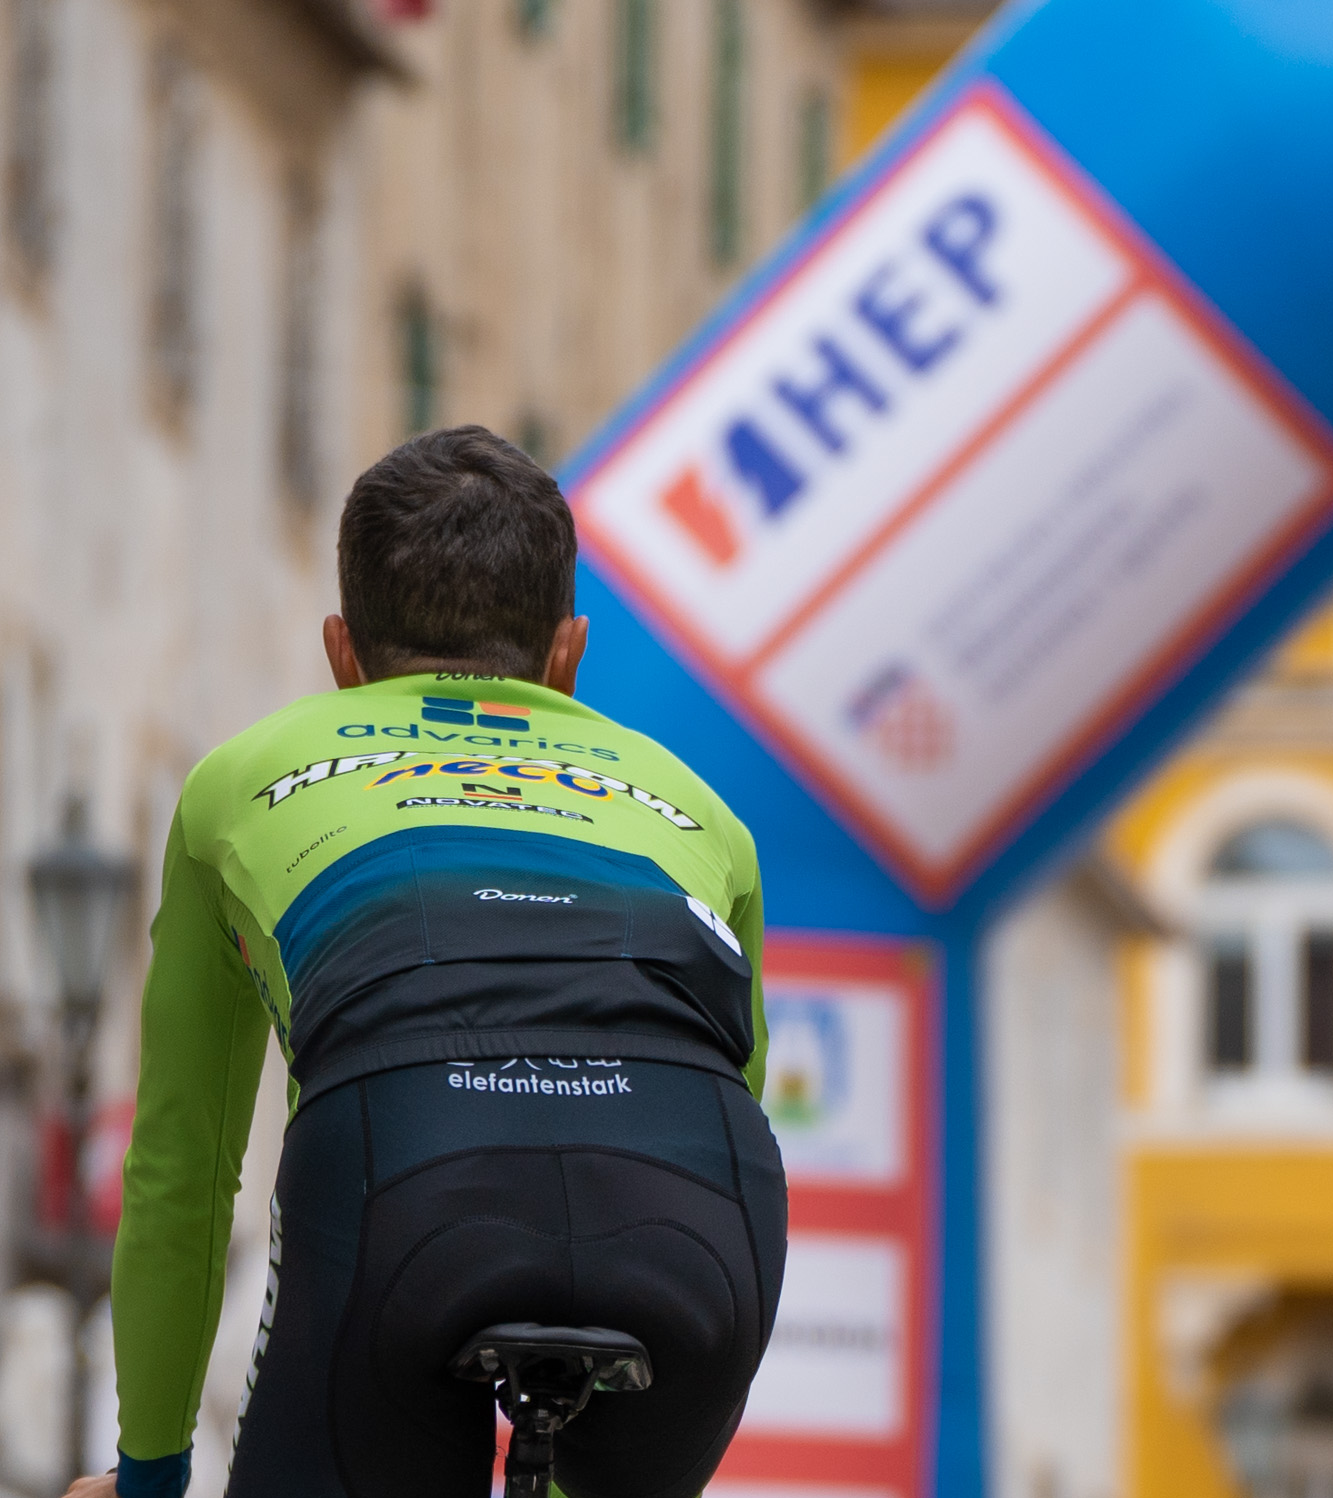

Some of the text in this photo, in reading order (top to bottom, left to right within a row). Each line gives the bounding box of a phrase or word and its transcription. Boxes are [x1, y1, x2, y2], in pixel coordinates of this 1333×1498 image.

[337, 723, 621, 762] advarics
[364, 759, 615, 802] neco
[405, 796, 585, 821] NOVATEC
[287, 825, 348, 874] tubolito
[448, 1070, 632, 1097] elefantenstark
